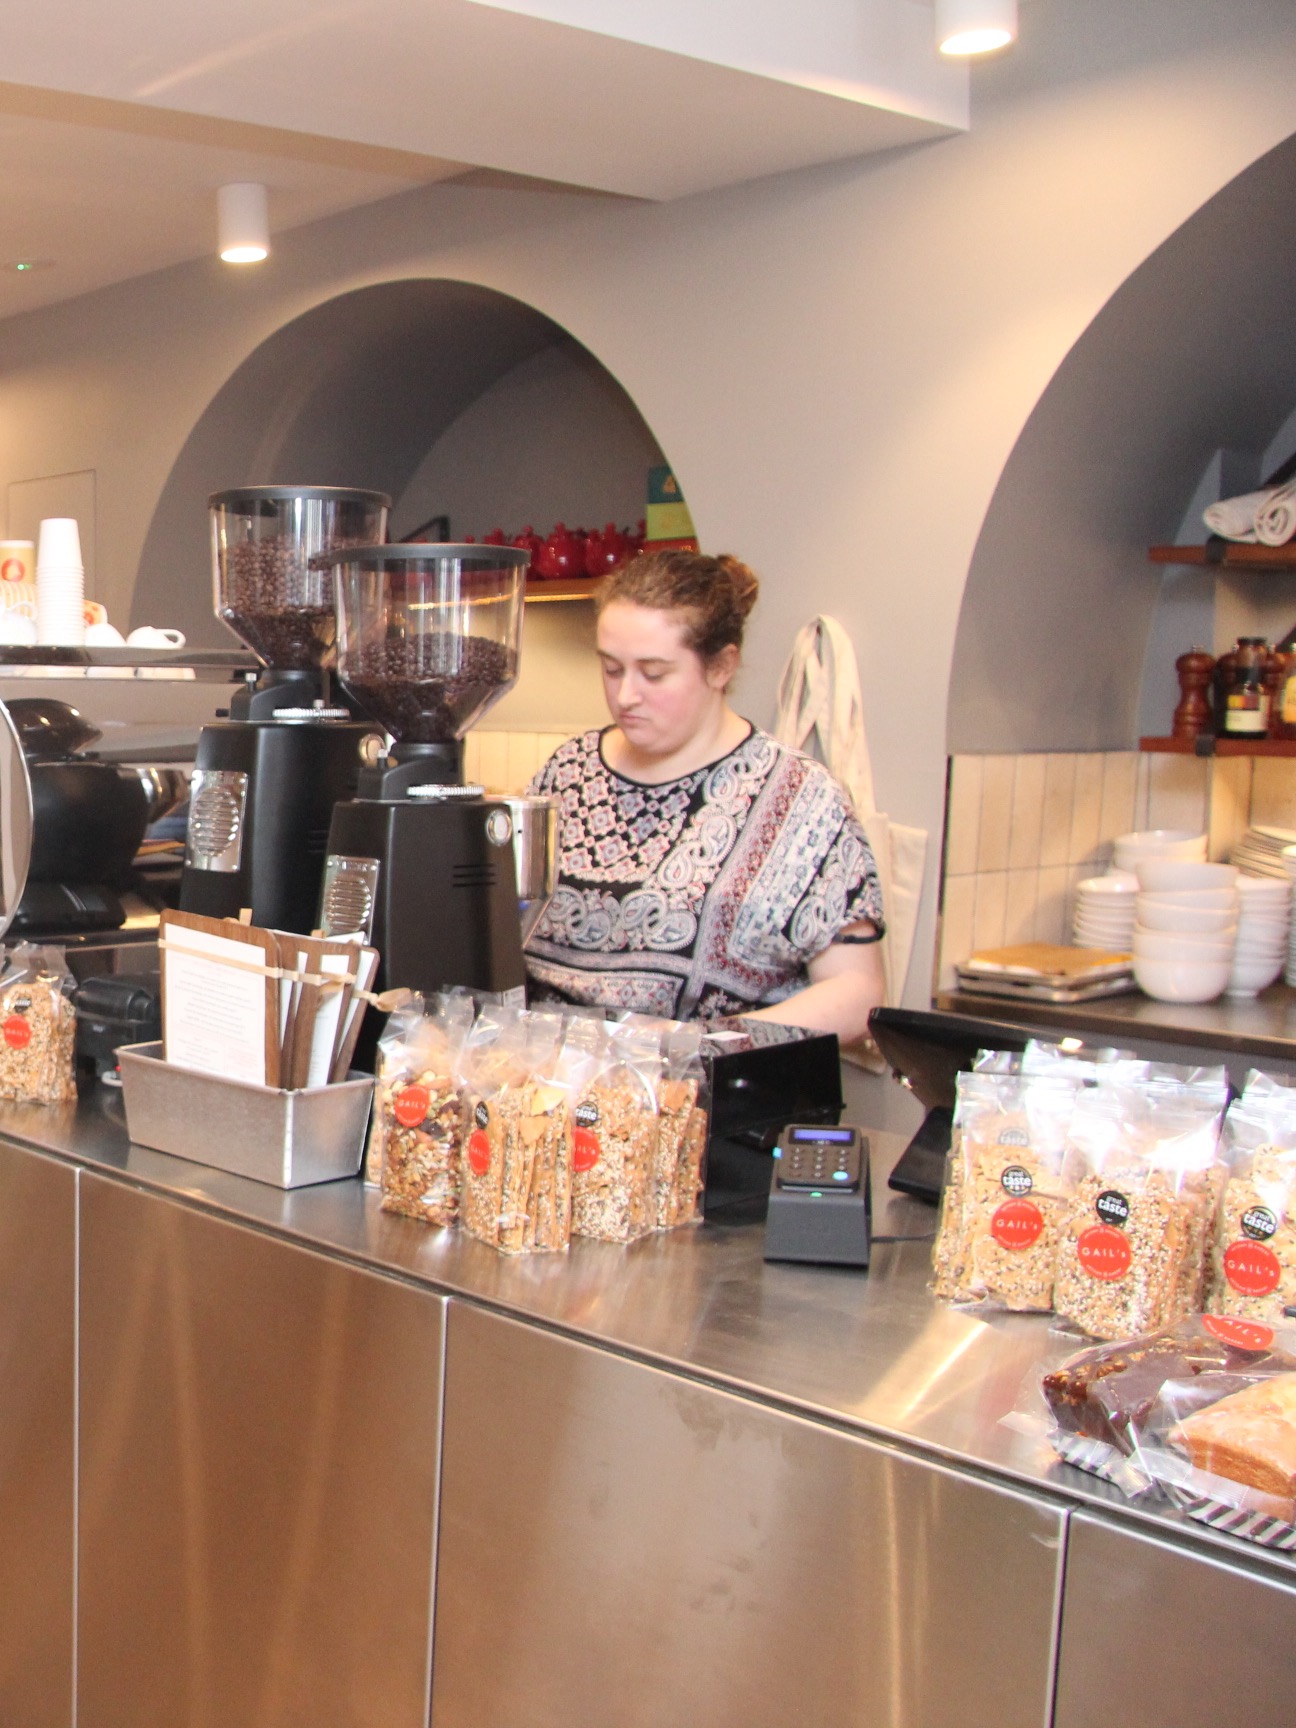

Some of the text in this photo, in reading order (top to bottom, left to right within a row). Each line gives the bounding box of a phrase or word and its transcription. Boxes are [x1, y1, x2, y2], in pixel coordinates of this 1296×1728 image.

[1002, 1176, 1032, 1187] taste
[1097, 1199, 1128, 1217] taste
[1253, 1210, 1272, 1222] great
[995, 1218, 1038, 1231] GAIL's
[1244, 1213, 1275, 1234] taste
[1082, 1246, 1126, 1259] GAIL's
[1227, 1259, 1275, 1278] GAIL's
